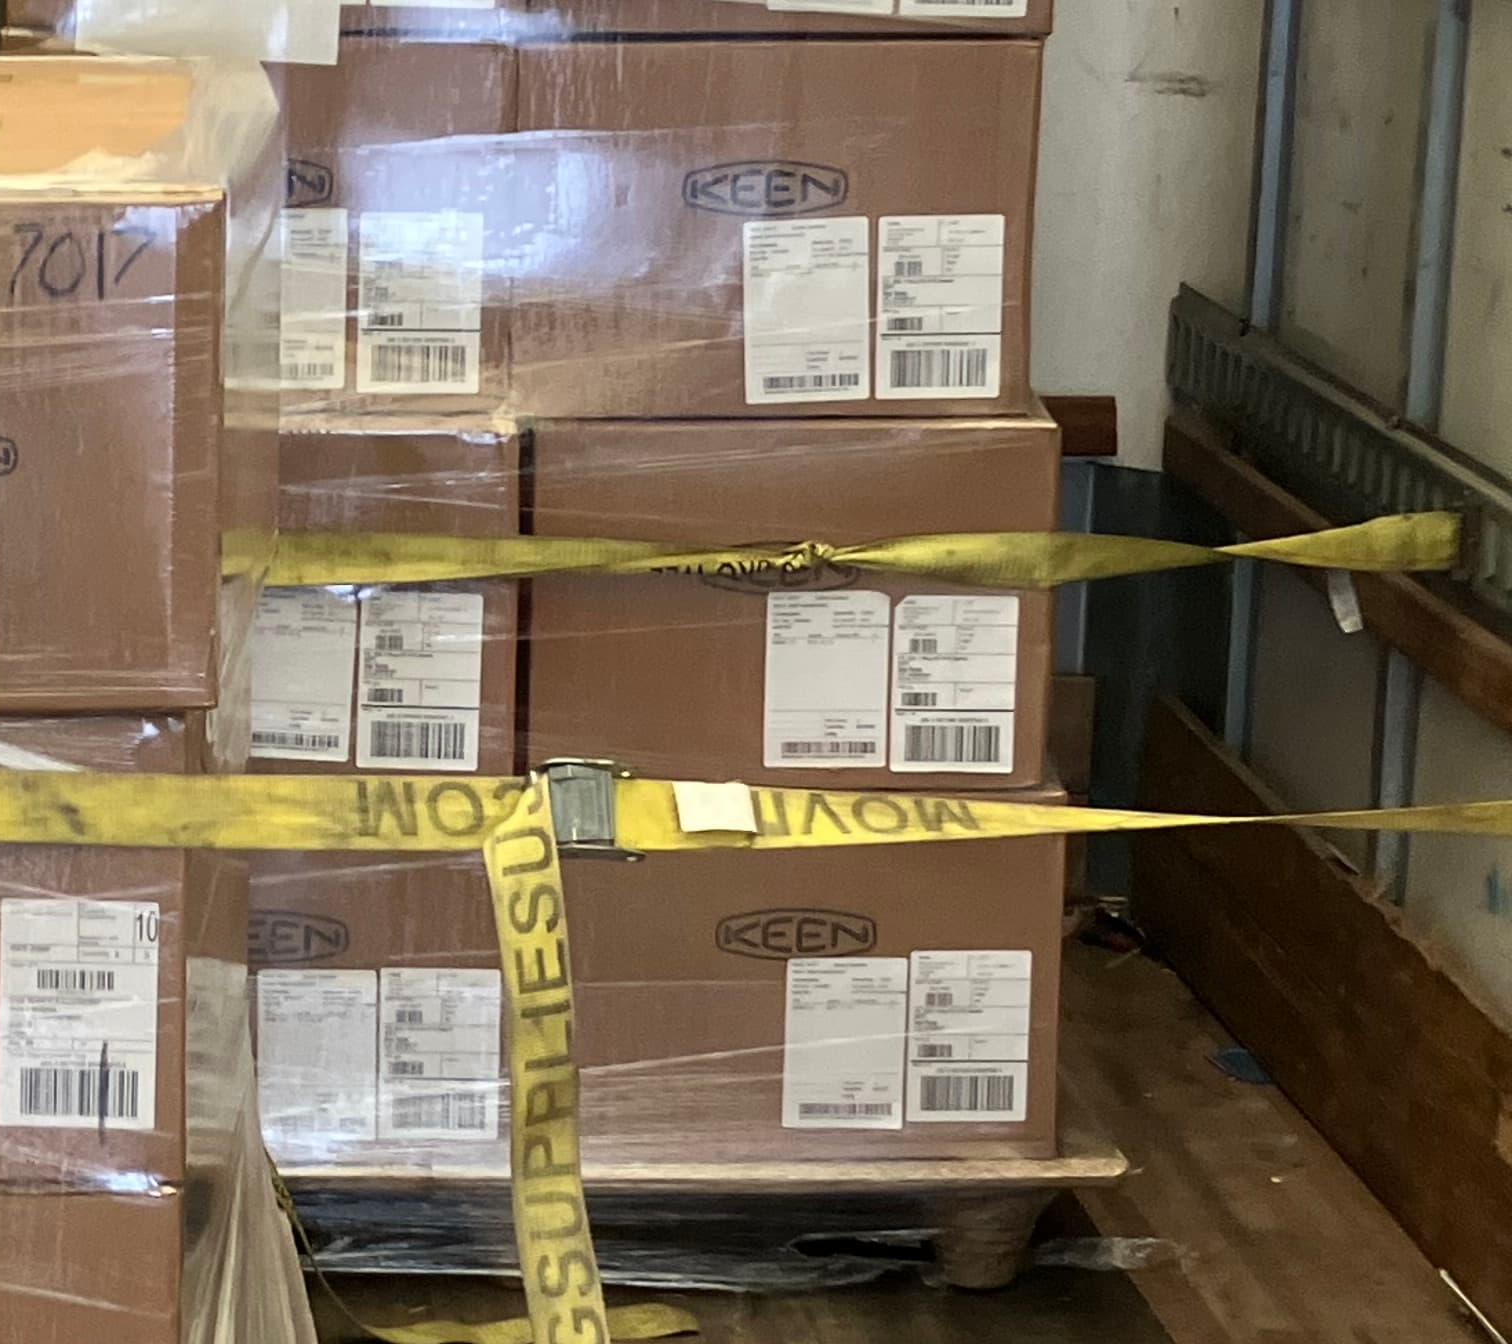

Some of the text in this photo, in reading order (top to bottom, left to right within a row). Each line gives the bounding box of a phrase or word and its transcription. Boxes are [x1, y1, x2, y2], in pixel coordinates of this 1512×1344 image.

[688, 168, 842, 205] KEEN
[7, 223, 158, 301] 7017
[137, 910, 159, 943] 10
[248, 918, 340, 954] EEN
[722, 916, 872, 953] KEEN
